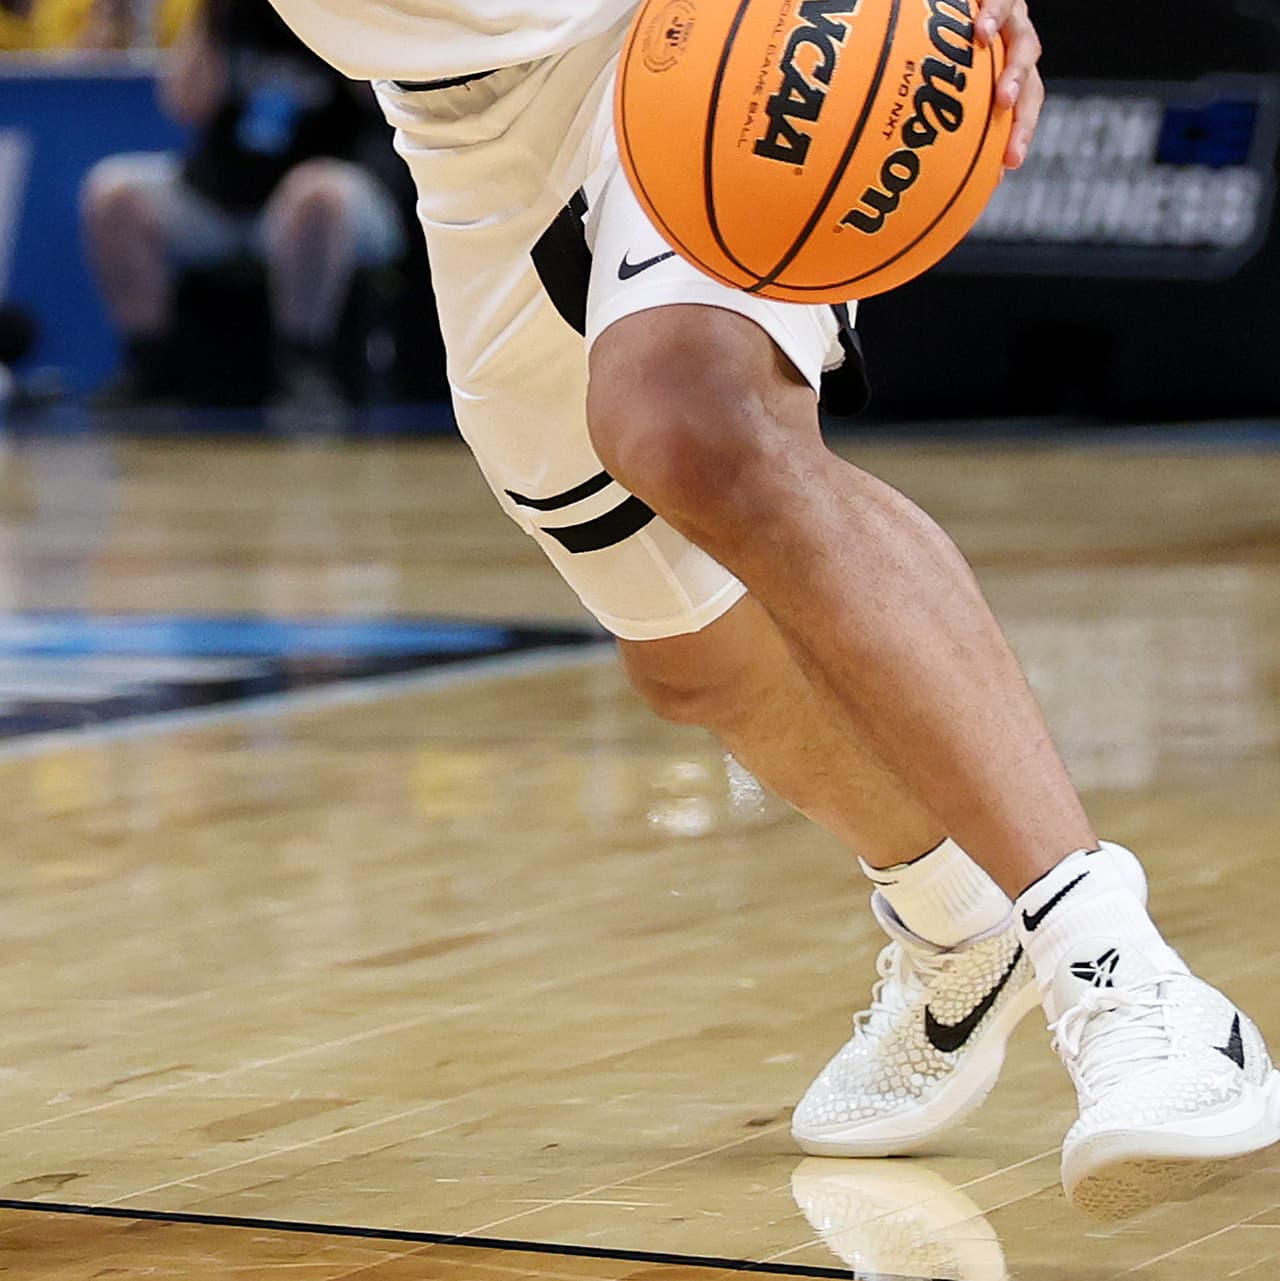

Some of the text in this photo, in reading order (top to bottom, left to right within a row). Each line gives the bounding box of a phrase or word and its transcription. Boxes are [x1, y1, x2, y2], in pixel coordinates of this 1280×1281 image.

[737, 101, 759, 149] BALL
[881, 60, 916, 141] EVO NXT
